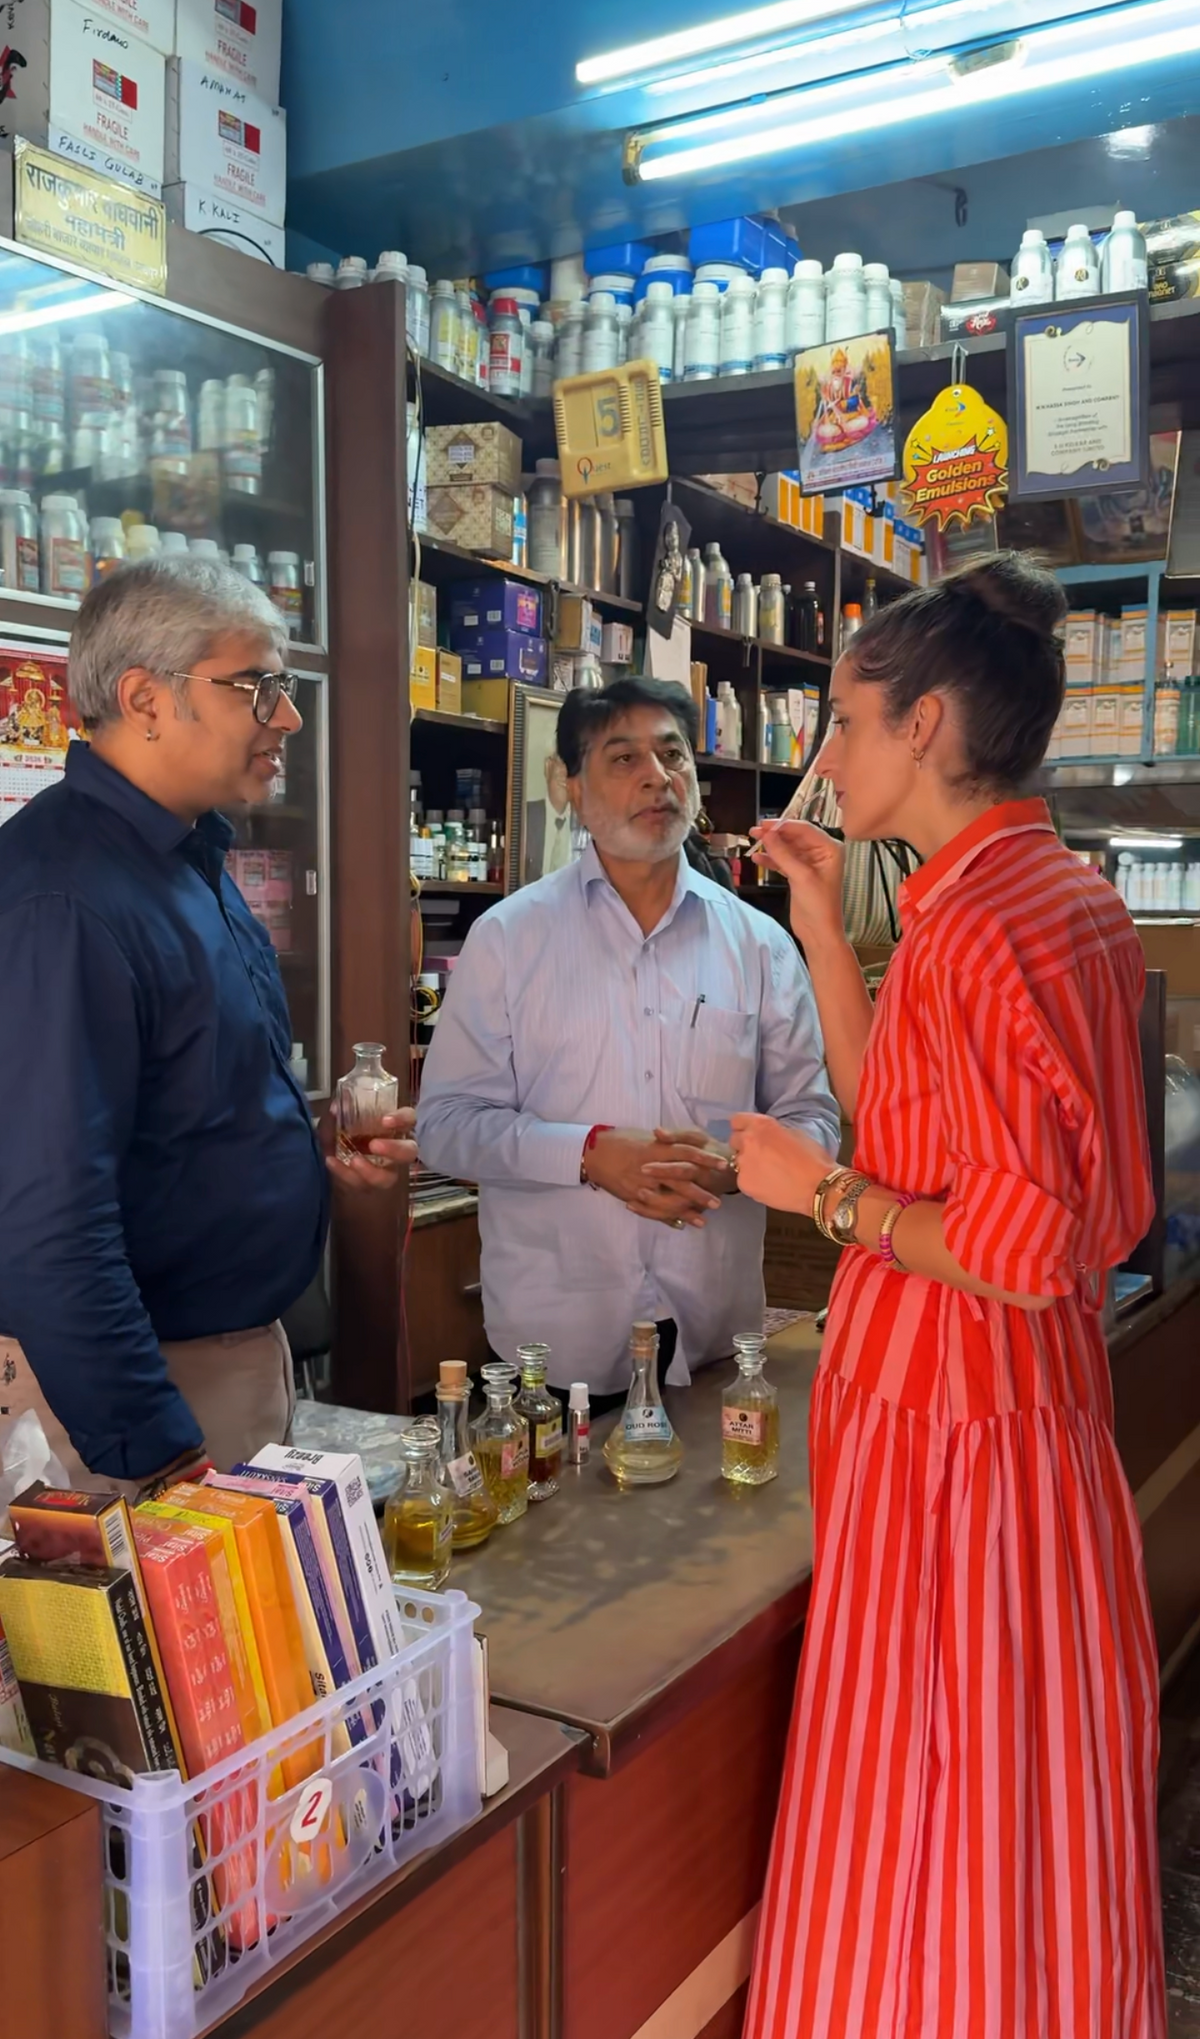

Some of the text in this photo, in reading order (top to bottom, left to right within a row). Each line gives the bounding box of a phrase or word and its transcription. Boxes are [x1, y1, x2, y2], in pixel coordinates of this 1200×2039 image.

[217, 39, 247, 67] FRAGILE
[97, 111, 128, 141] FRAGILE
[104, 157, 145, 186] GULAB
[227, 163, 255, 187] FRAGILE
[596, 396, 620, 437] 5
[926, 461, 982, 483] Golden
[915, 474, 997, 504] Emulsions
[625, 1422, 645, 1431] OUD
[729, 1421, 754, 1430] ATTAR
[731, 1427, 752, 1436] MITTI
[284, 1449, 324, 1465] Breezy
[301, 1790, 323, 1829] 2
